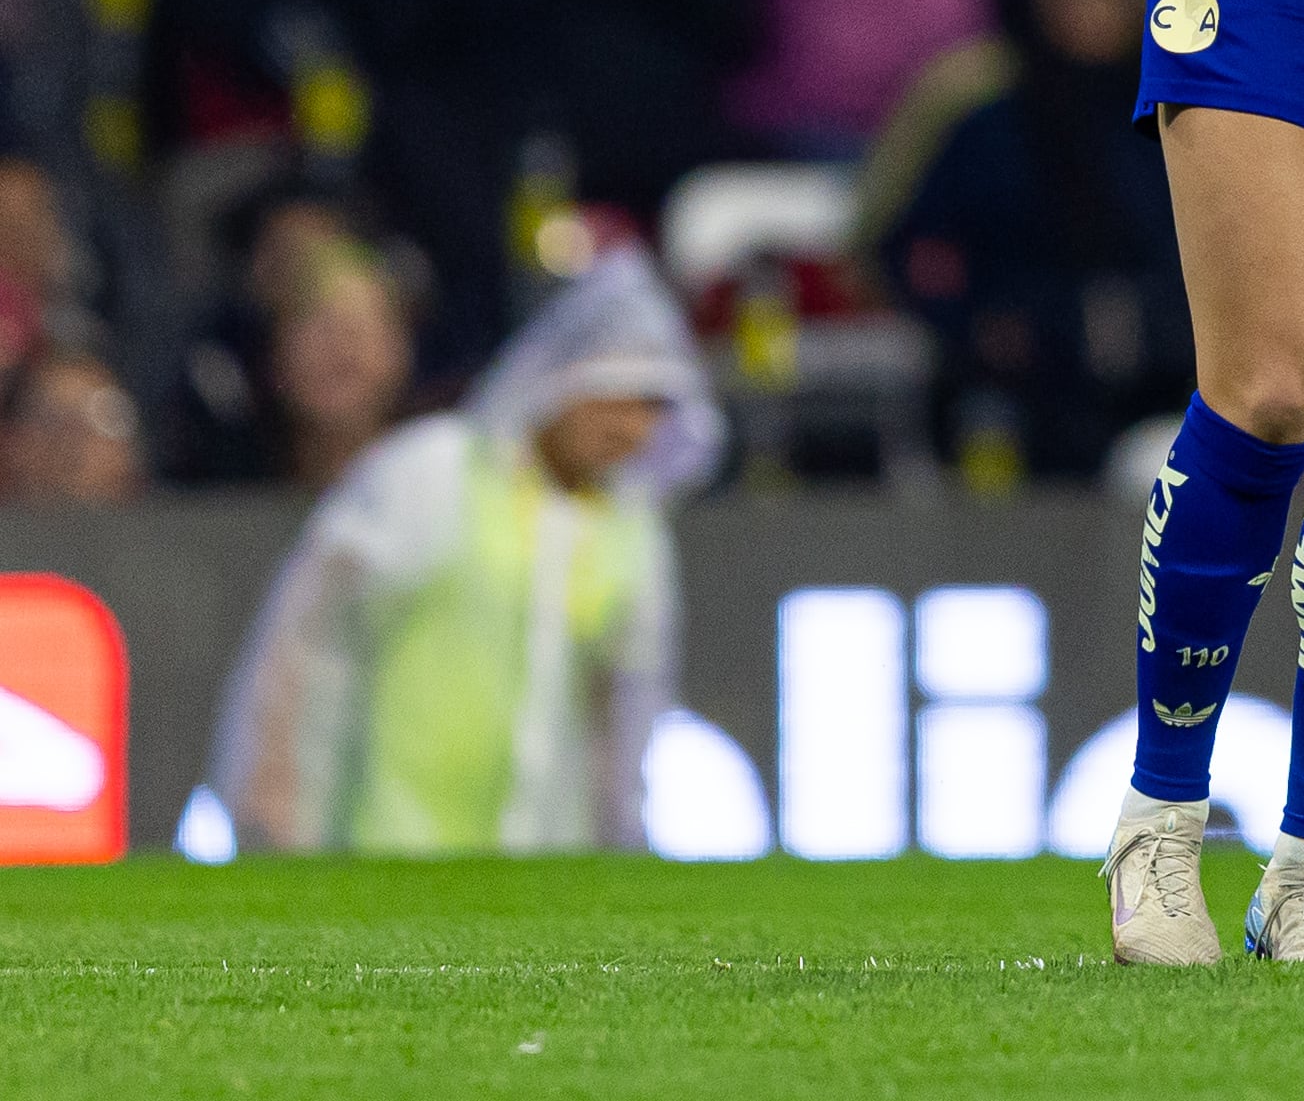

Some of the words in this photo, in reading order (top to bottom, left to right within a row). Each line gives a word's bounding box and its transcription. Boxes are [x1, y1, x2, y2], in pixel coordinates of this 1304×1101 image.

[1153, 5, 1177, 29] C
[1199, 7, 1215, 32] A
[1138, 464, 1190, 652] JUMEX
[1176, 645, 1229, 668] 110
